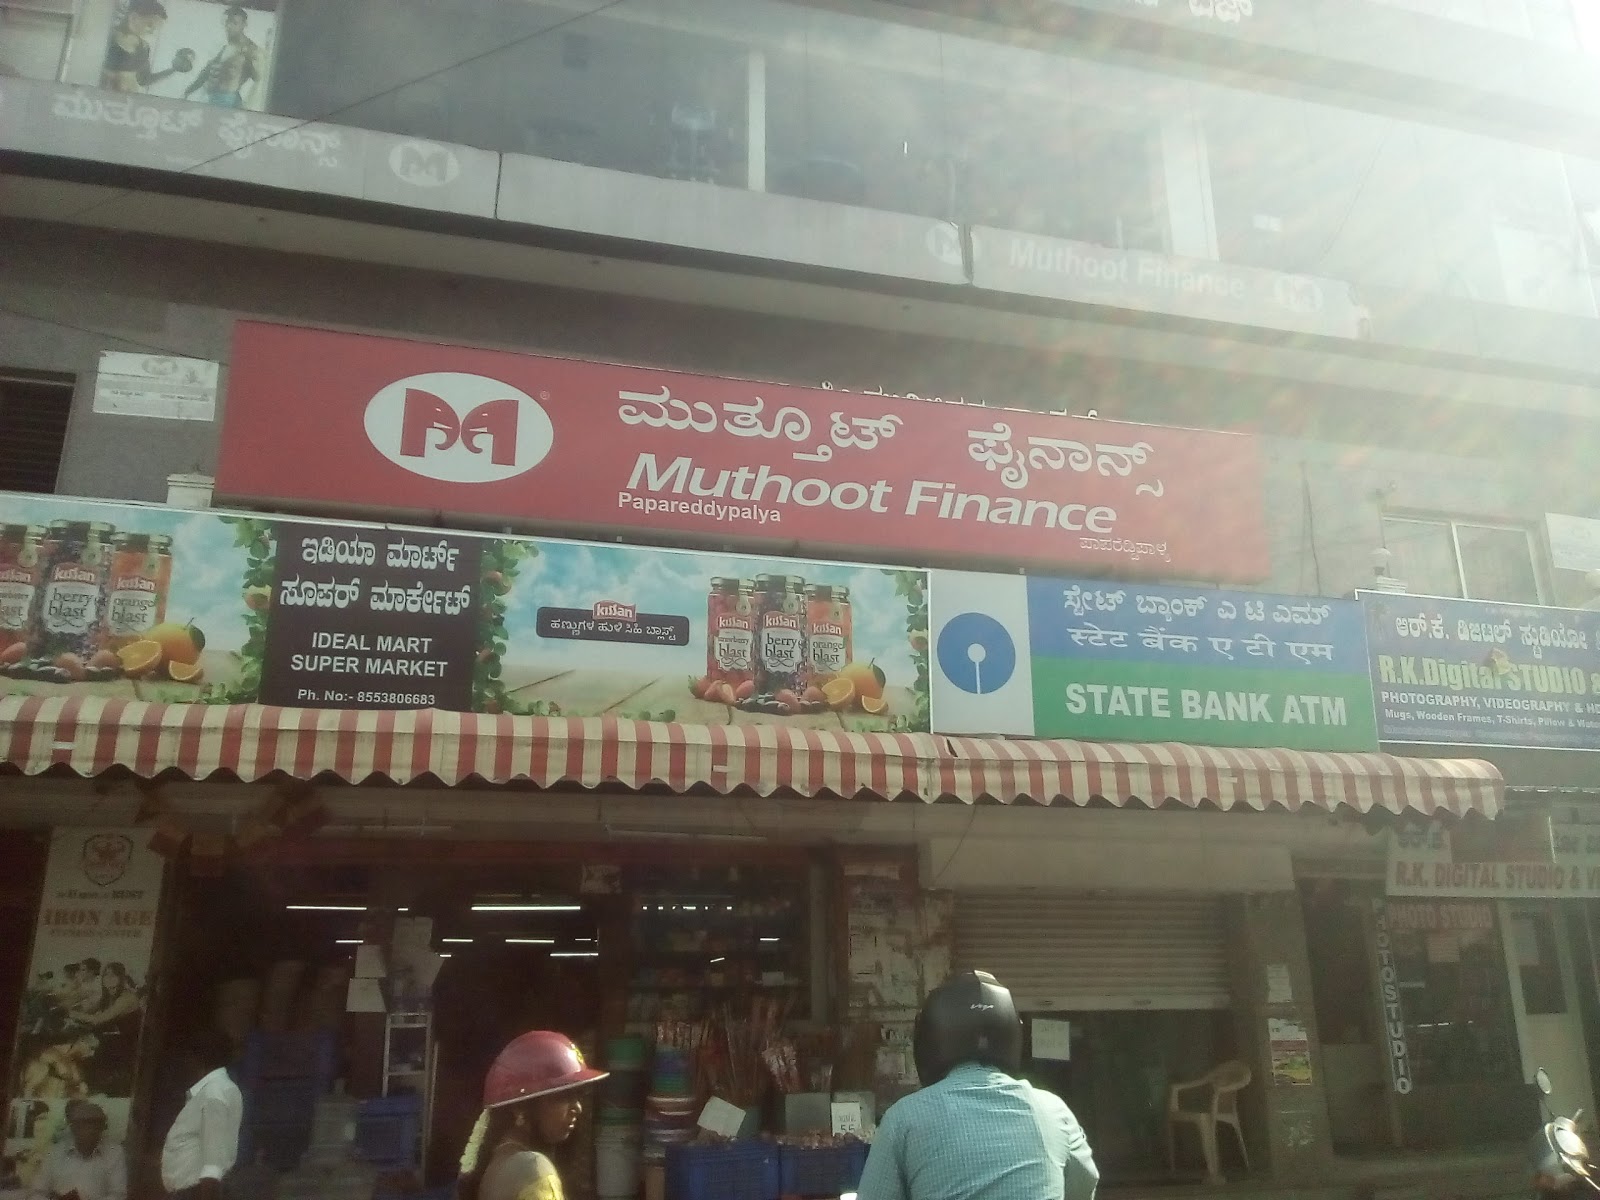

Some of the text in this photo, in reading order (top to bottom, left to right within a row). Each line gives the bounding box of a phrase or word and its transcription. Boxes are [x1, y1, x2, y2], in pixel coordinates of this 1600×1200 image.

[1008, 238, 1248, 299] Muthoot Finance
[618, 385, 904, 463] ಮುತ್ತೂಟ್
[967, 422, 1164, 498] ಫೈನಾನ್ಸ್
[626, 452, 1118, 534] Muthoot Finance
[618, 492, 781, 524] Papareddypalya
[386, 537, 460, 572] ಮಾರ್ಟ್
[53, 587, 94, 606] berry
[279, 573, 361, 608] ಸೂಪರ್
[48, 600, 87, 617] blast
[111, 606, 148, 622] blast
[596, 603, 633, 618] kissan
[1063, 585, 1127, 616] ಸ್ಟೇಟ್
[1136, 595, 1207, 622] ಬ್ಯಾಂಕ್
[718, 616, 749, 629] kissan
[765, 614, 796, 629] kissan
[813, 622, 842, 635] kissan
[312, 632, 432, 654] IDEAL MART
[766, 632, 797, 647] berry
[1066, 622, 1335, 665] स्टेट बैंक ए टी एम
[718, 643, 747, 659] blast
[765, 643, 794, 659] blast
[812, 648, 840, 663] blast
[290, 654, 448, 677] SUPER MARKET
[1507, 664, 1587, 696] STUDIO
[297, 688, 319, 701] Ph.
[356, 691, 436, 706] 8553806683
[1065, 683, 1348, 726] STATE BANK ATM
[1381, 691, 1481, 710] PHOTOGRAPHY,
[1482, 696, 1571, 713] VIDEOGRAPHY
[1574, 702, 1585, 714] &
[1385, 708, 1415, 721] Mugs,
[1416, 710, 1455, 721] Wooden
[1457, 713, 1495, 725] Frames,
[1434, 862, 1500, 889] DIGITAL
